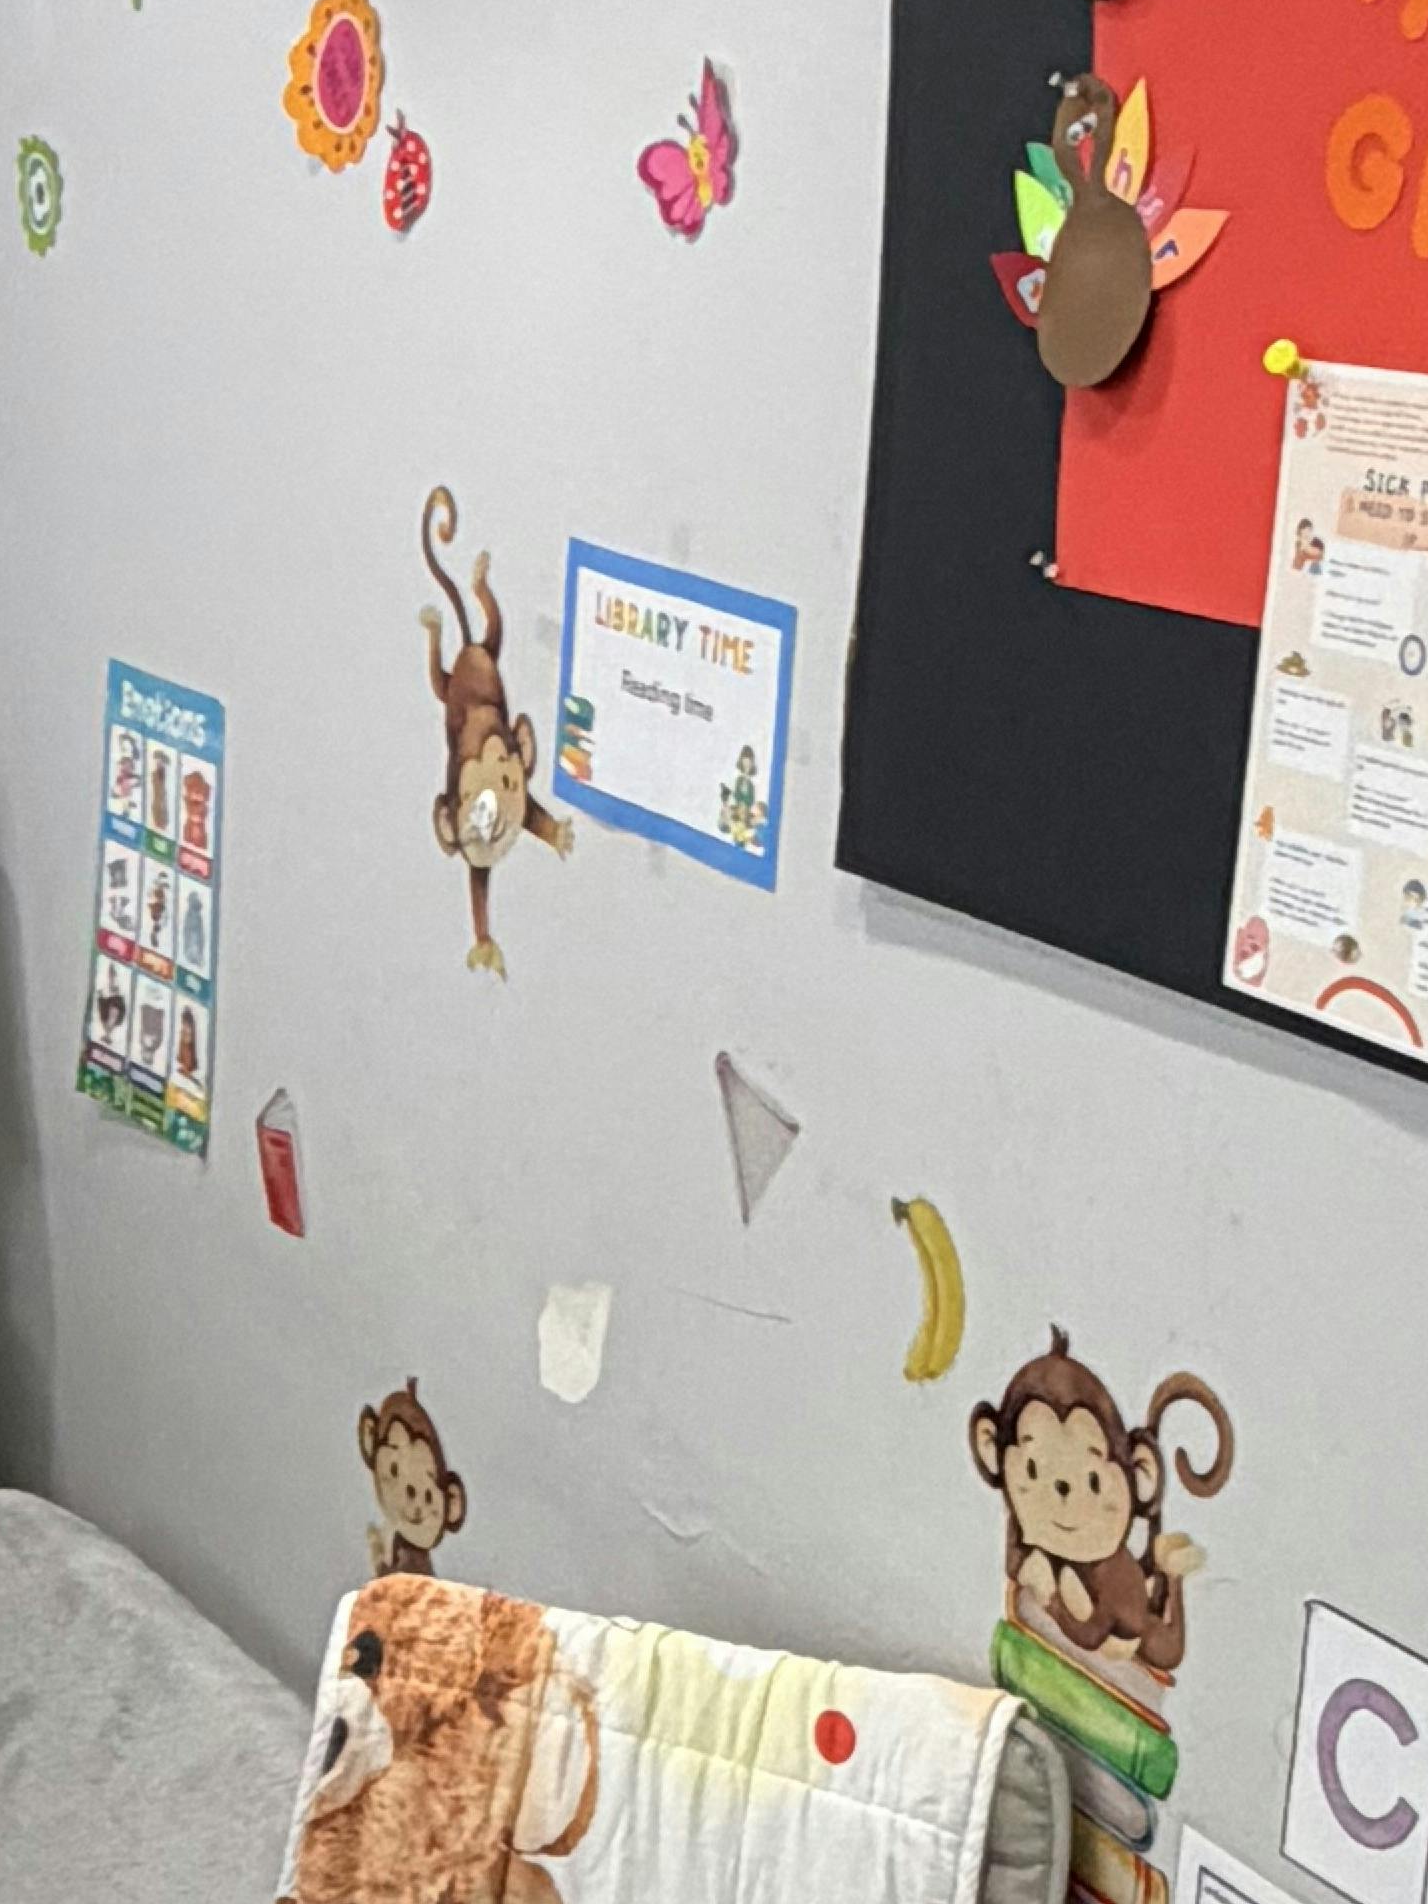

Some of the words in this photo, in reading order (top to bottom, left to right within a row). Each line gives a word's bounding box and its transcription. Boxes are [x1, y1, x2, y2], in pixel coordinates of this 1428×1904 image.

[1362, 468, 1410, 496] SICK
[595, 590, 690, 652] LIBRARY
[698, 623, 755, 676] TIME
